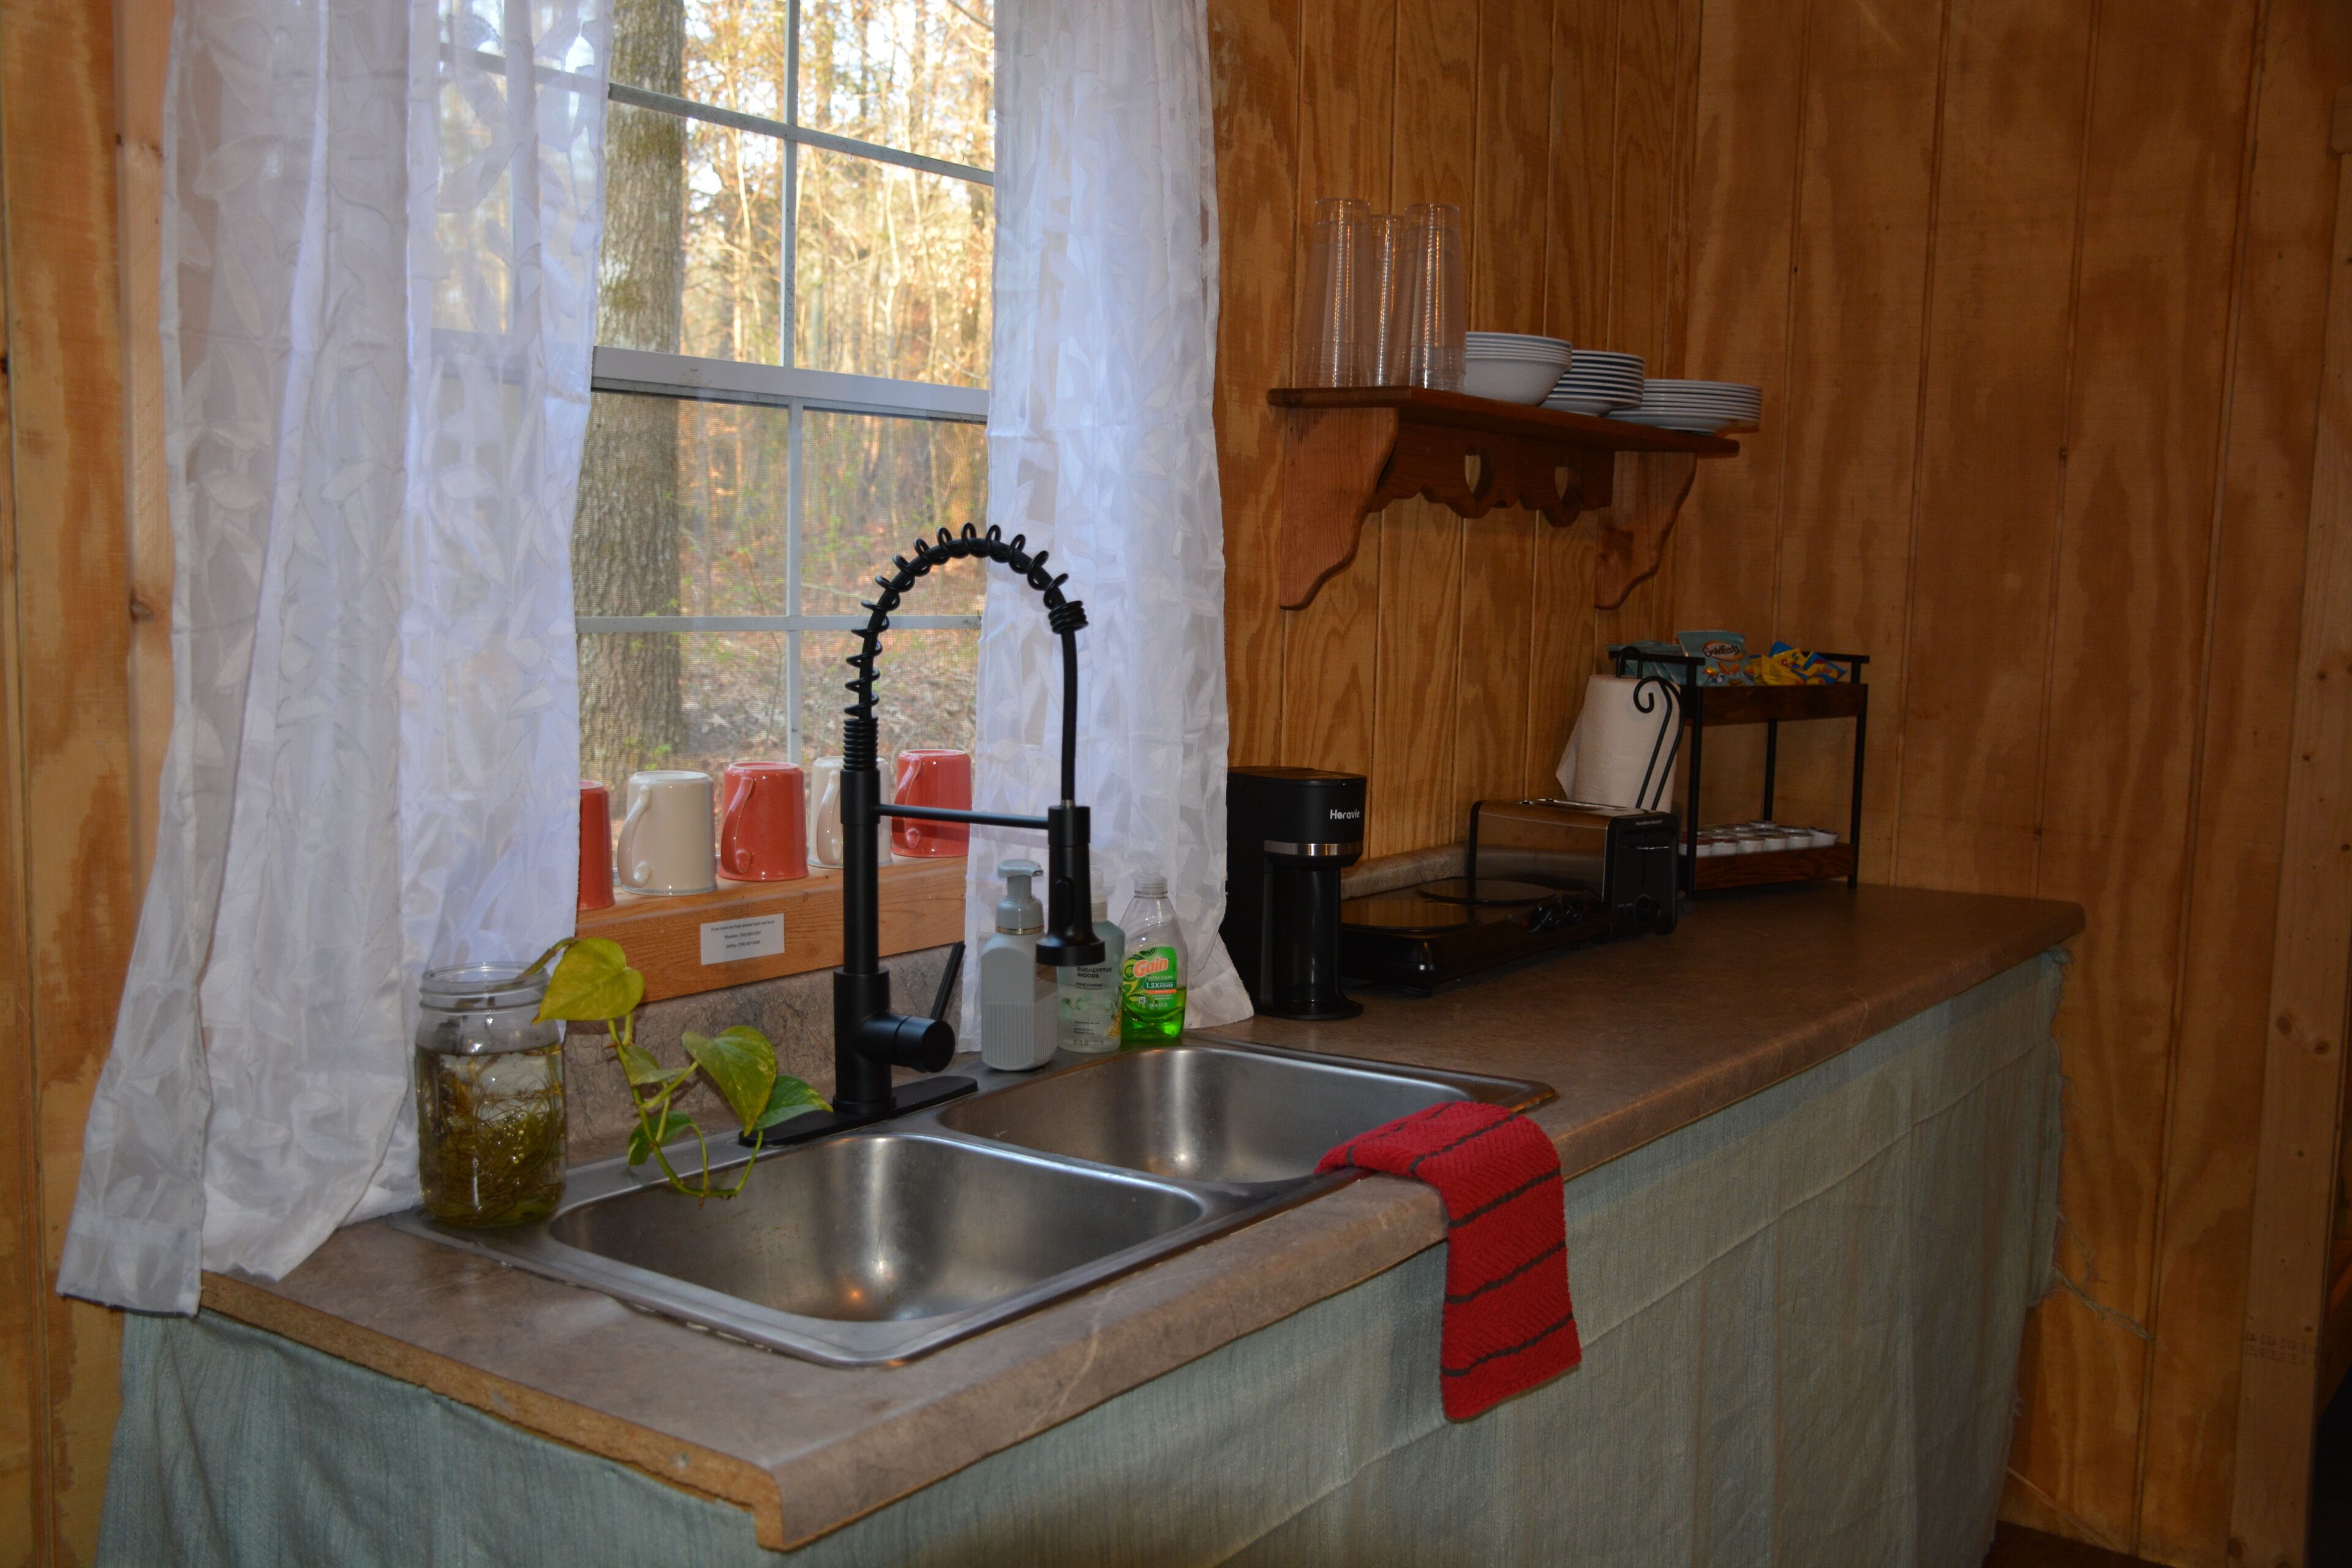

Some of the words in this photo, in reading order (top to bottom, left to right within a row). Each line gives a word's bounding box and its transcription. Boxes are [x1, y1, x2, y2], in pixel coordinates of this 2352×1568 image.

[1702, 644, 1739, 657] Goldfish
[1330, 809, 1360, 820] Horavie
[1133, 957, 1169, 978] Gain
